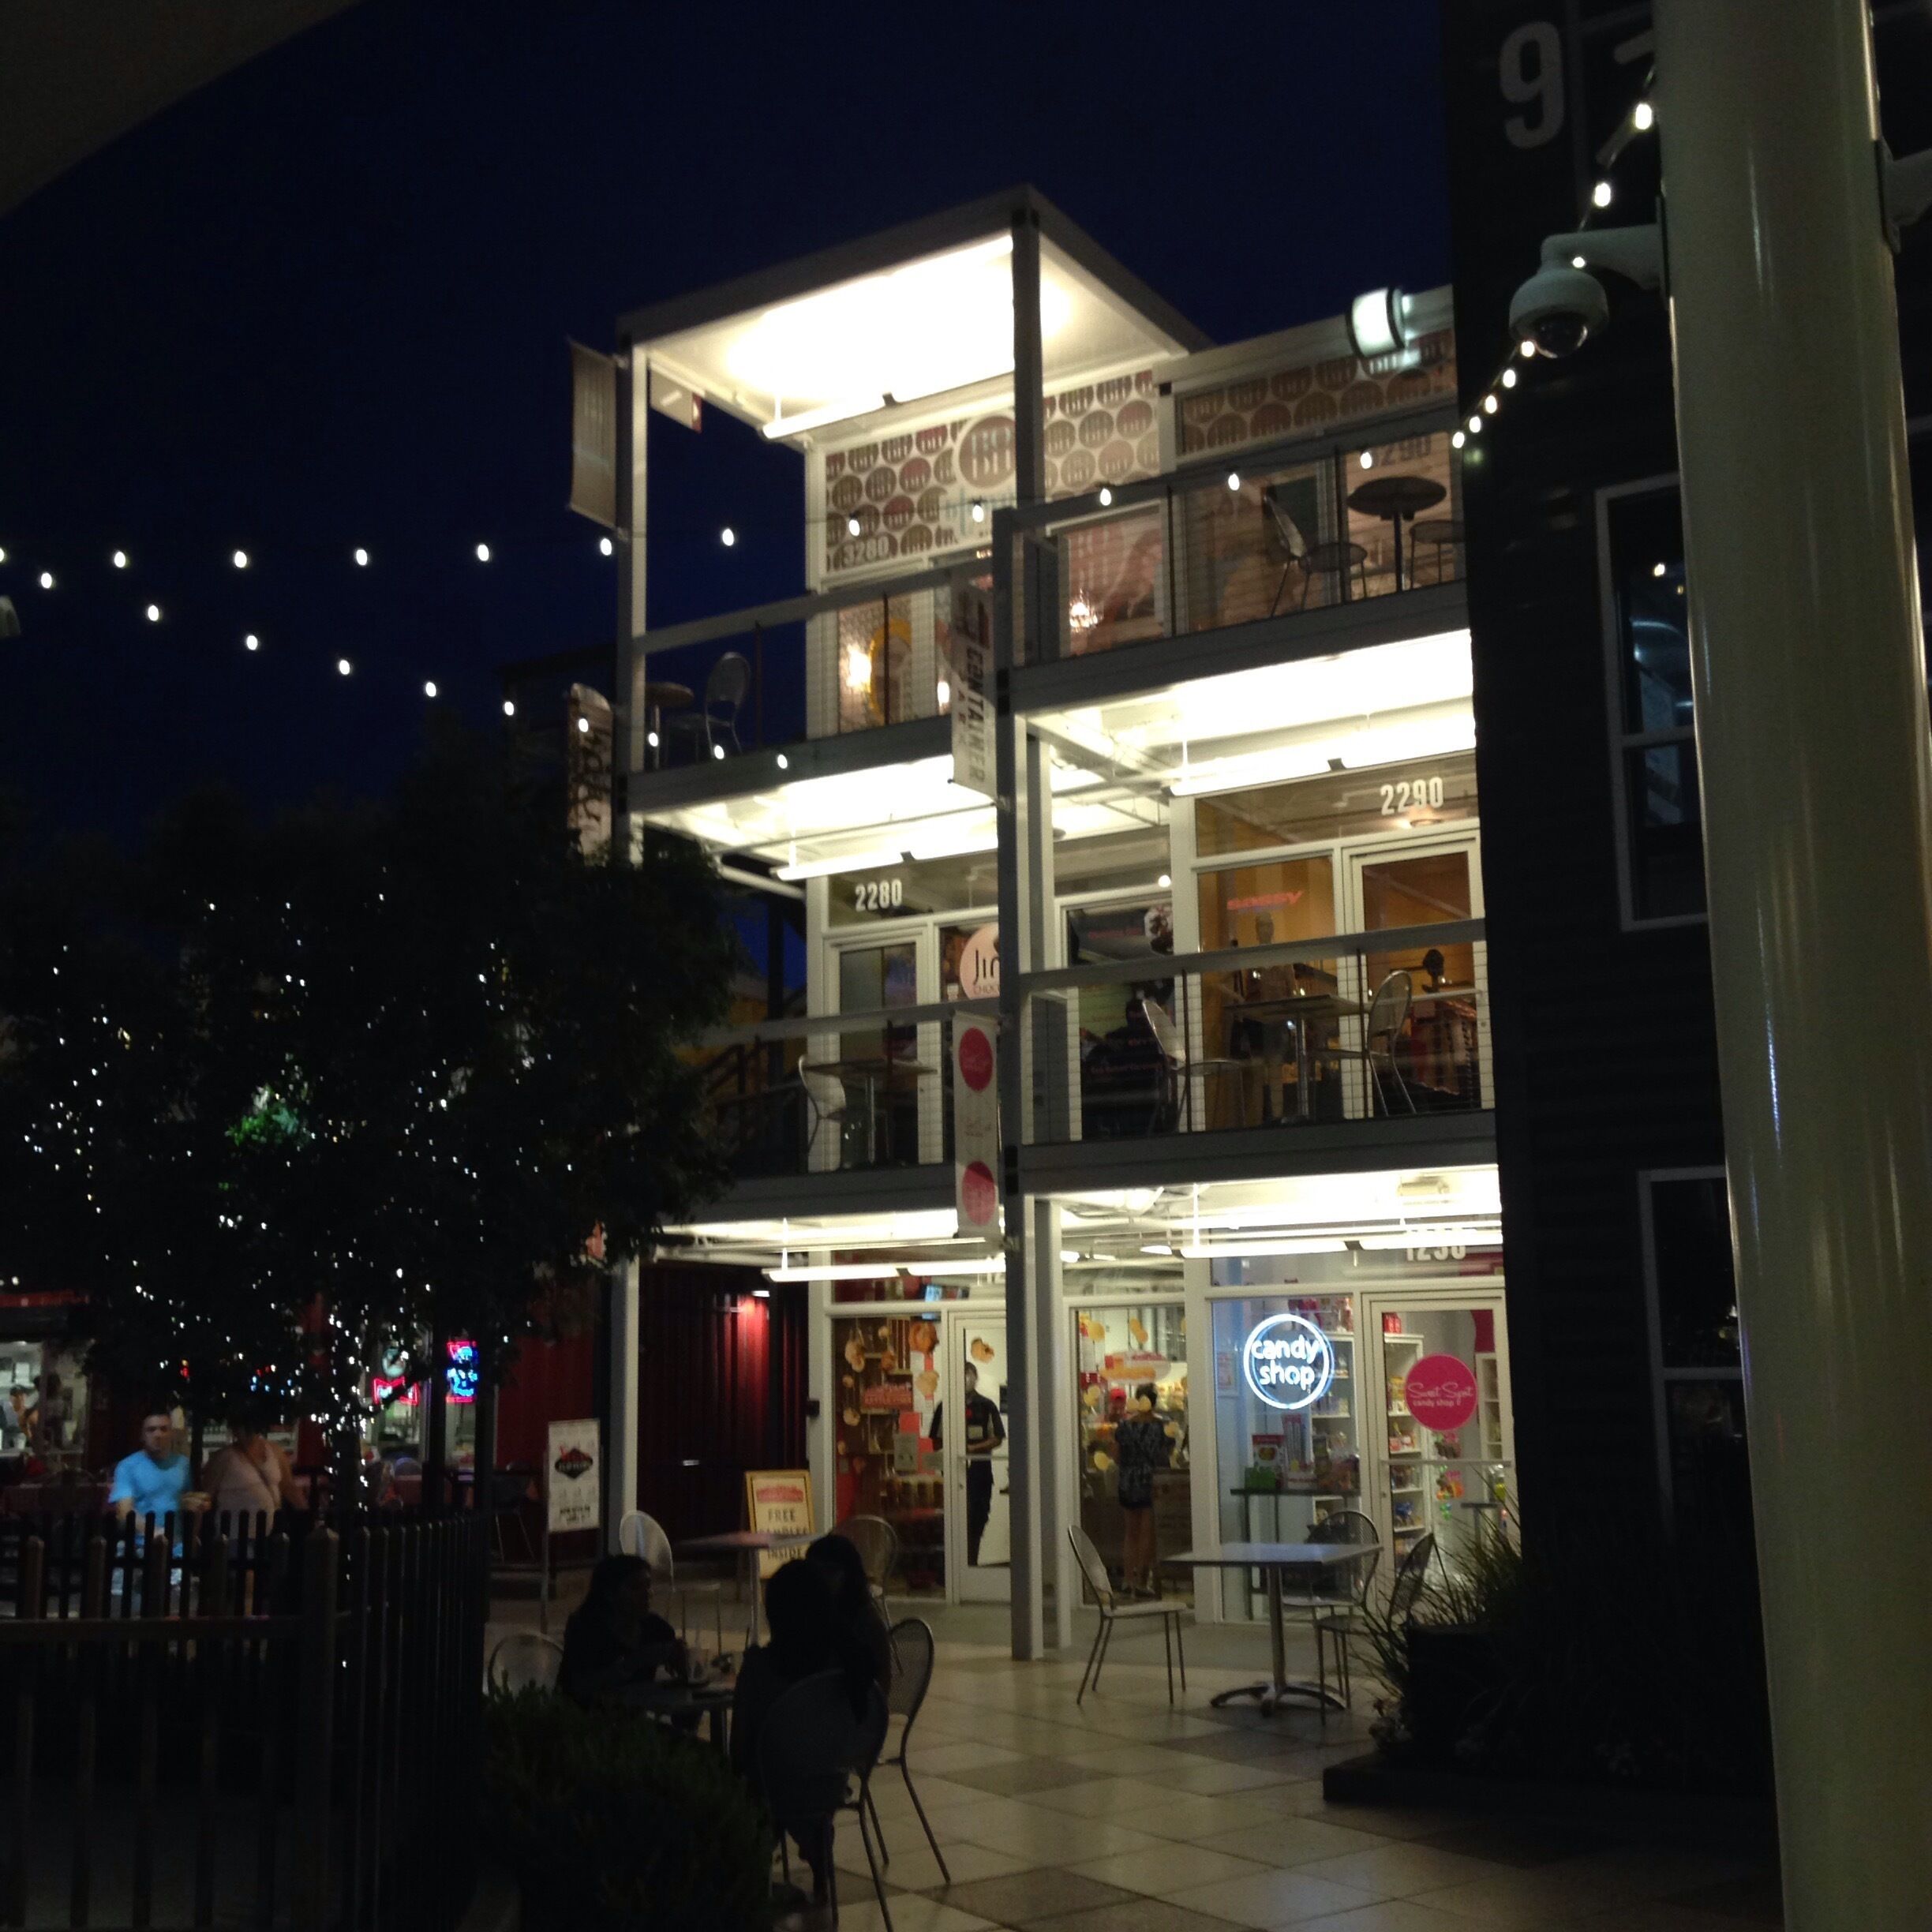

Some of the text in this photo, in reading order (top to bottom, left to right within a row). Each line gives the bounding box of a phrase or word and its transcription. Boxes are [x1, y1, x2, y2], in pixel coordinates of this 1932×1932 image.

[1380, 776, 1445, 816] 2290
[855, 878, 903, 912] 2280
[1251, 1334, 1321, 1364] candy
[1259, 1359, 1316, 1391] shop
[768, 1508, 796, 1522] FREE
